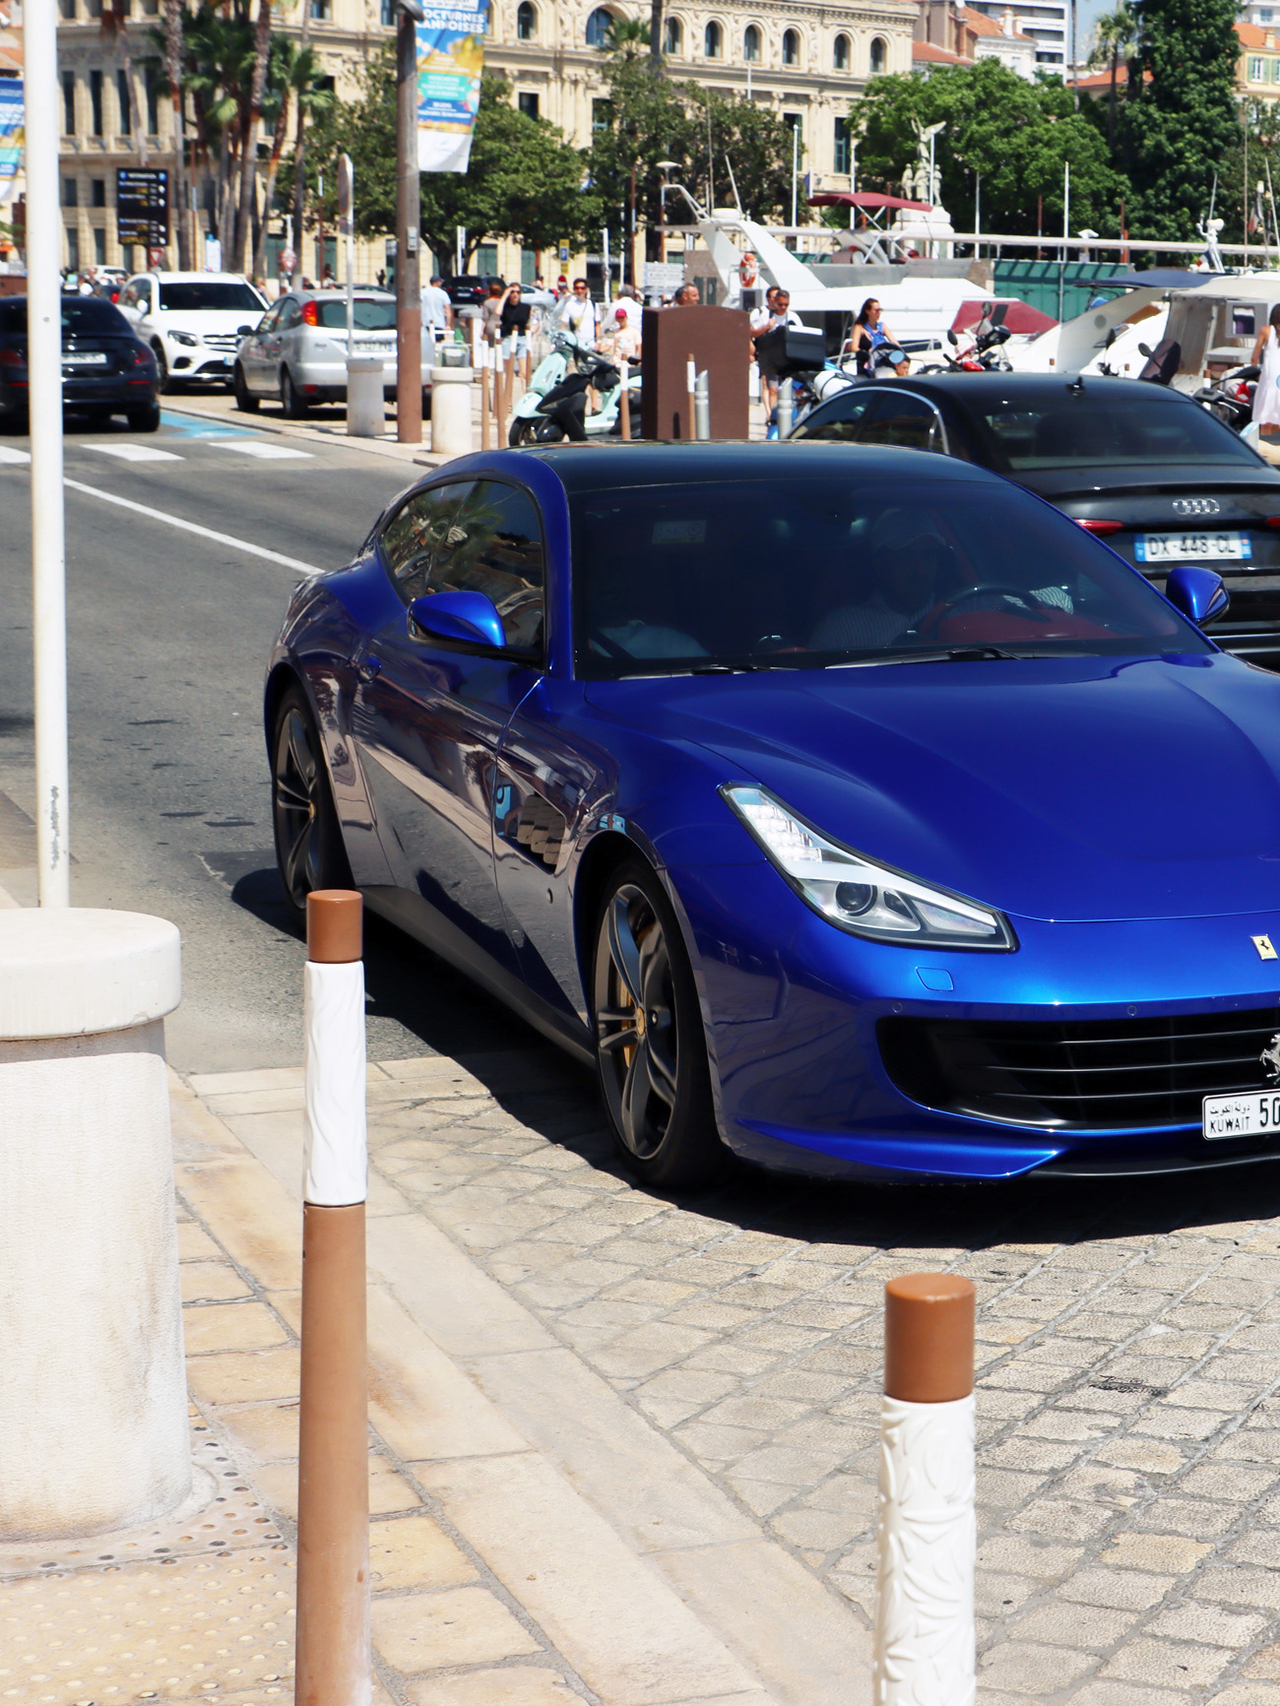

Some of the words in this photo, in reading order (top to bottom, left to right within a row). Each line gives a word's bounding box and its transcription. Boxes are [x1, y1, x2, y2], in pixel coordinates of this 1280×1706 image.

[423, 8, 485, 23] OCTURNES
[1210, 1103, 1233, 1118] الكويت
[1234, 1100, 1250, 1114] دولة
[1210, 1116, 1250, 1134] KUWAIT
